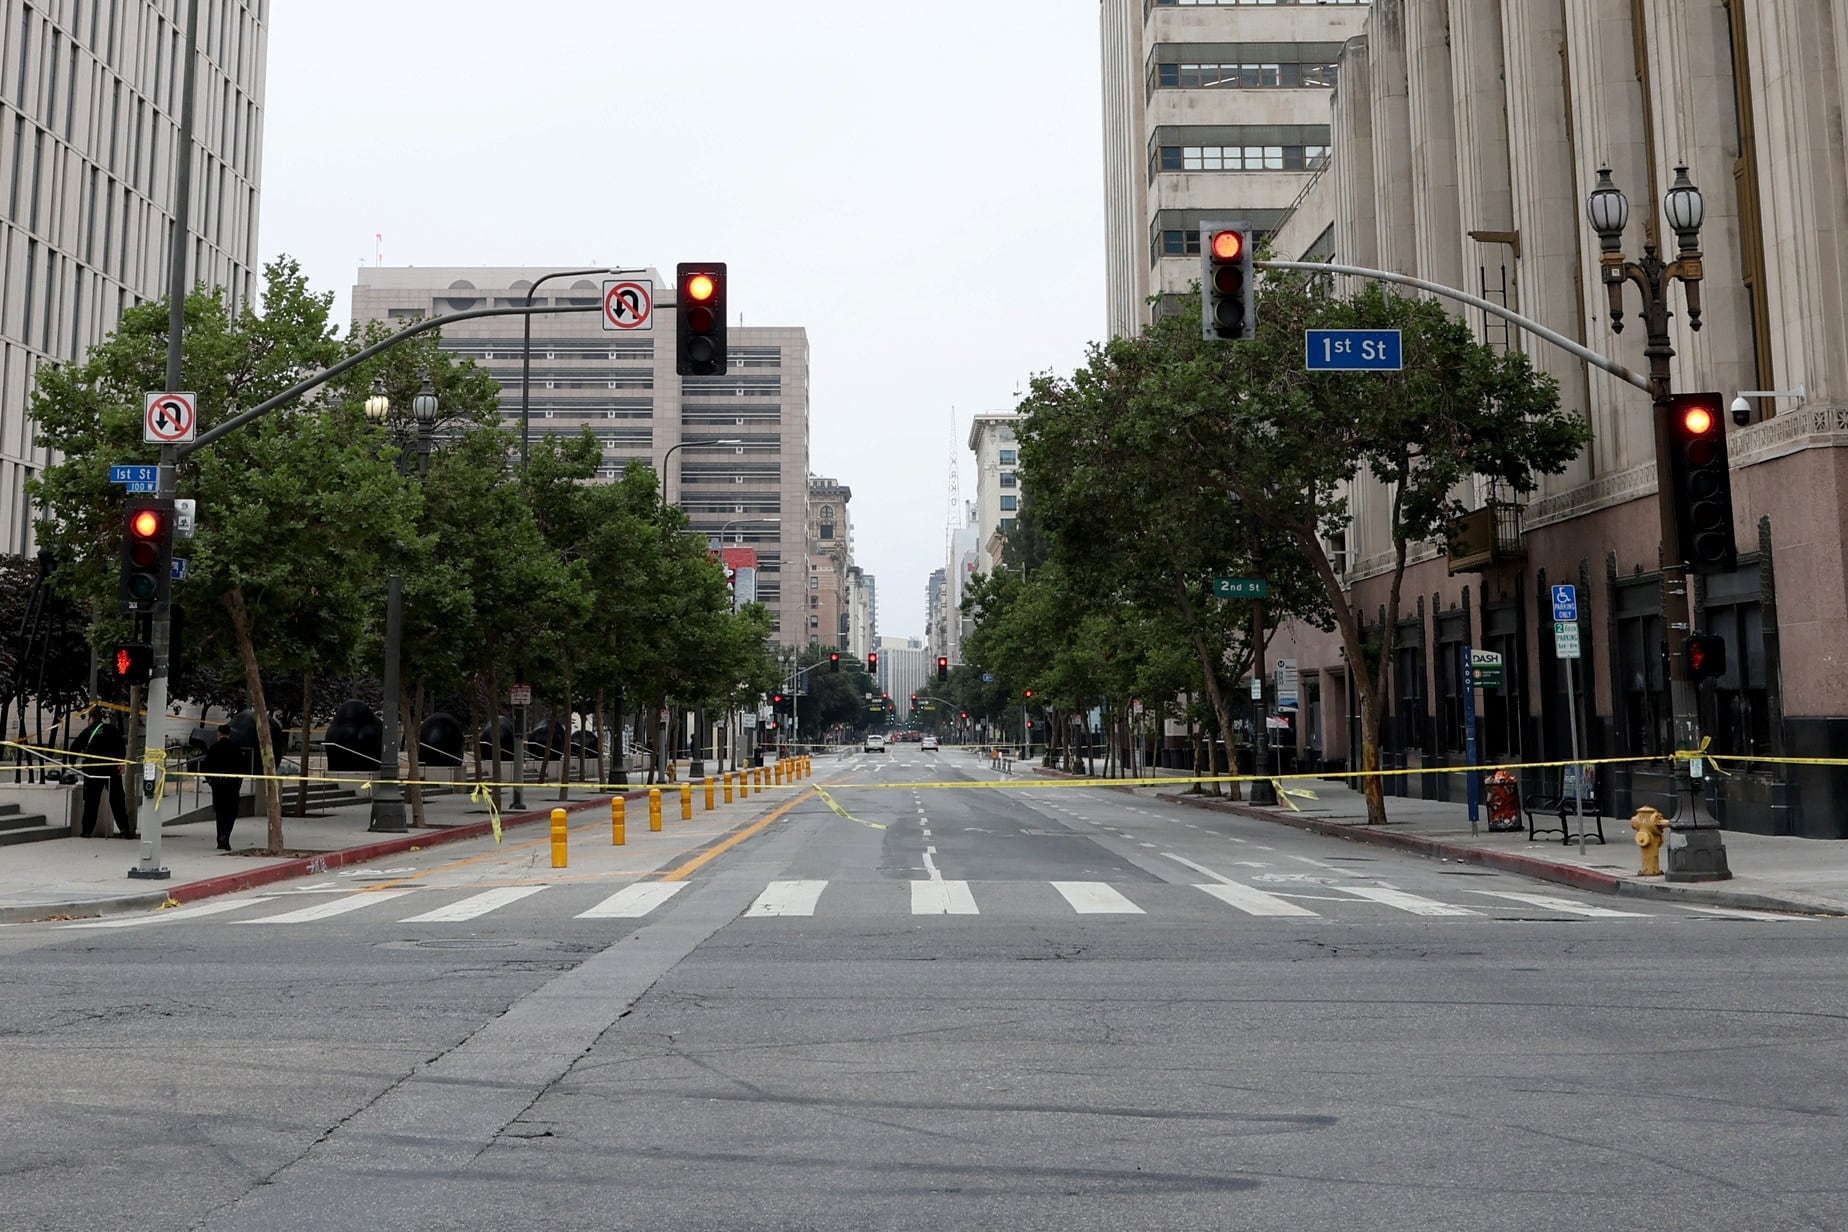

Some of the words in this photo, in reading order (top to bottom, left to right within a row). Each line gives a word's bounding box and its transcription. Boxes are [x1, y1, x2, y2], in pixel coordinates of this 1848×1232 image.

[1323, 338, 1352, 362] 1st
[1361, 340, 1387, 360] St
[116, 469, 131, 480] 1st
[139, 469, 151, 480] St
[131, 483, 145, 491] 100
[147, 483, 154, 491] W
[1220, 581, 1242, 592] 2nd
[1249, 583, 1260, 592] St
[1555, 603, 1576, 611] PARKING
[1559, 611, 1572, 619] ONLY
[1557, 624, 1564, 632] 2
[1473, 654, 1499, 663] DASH
